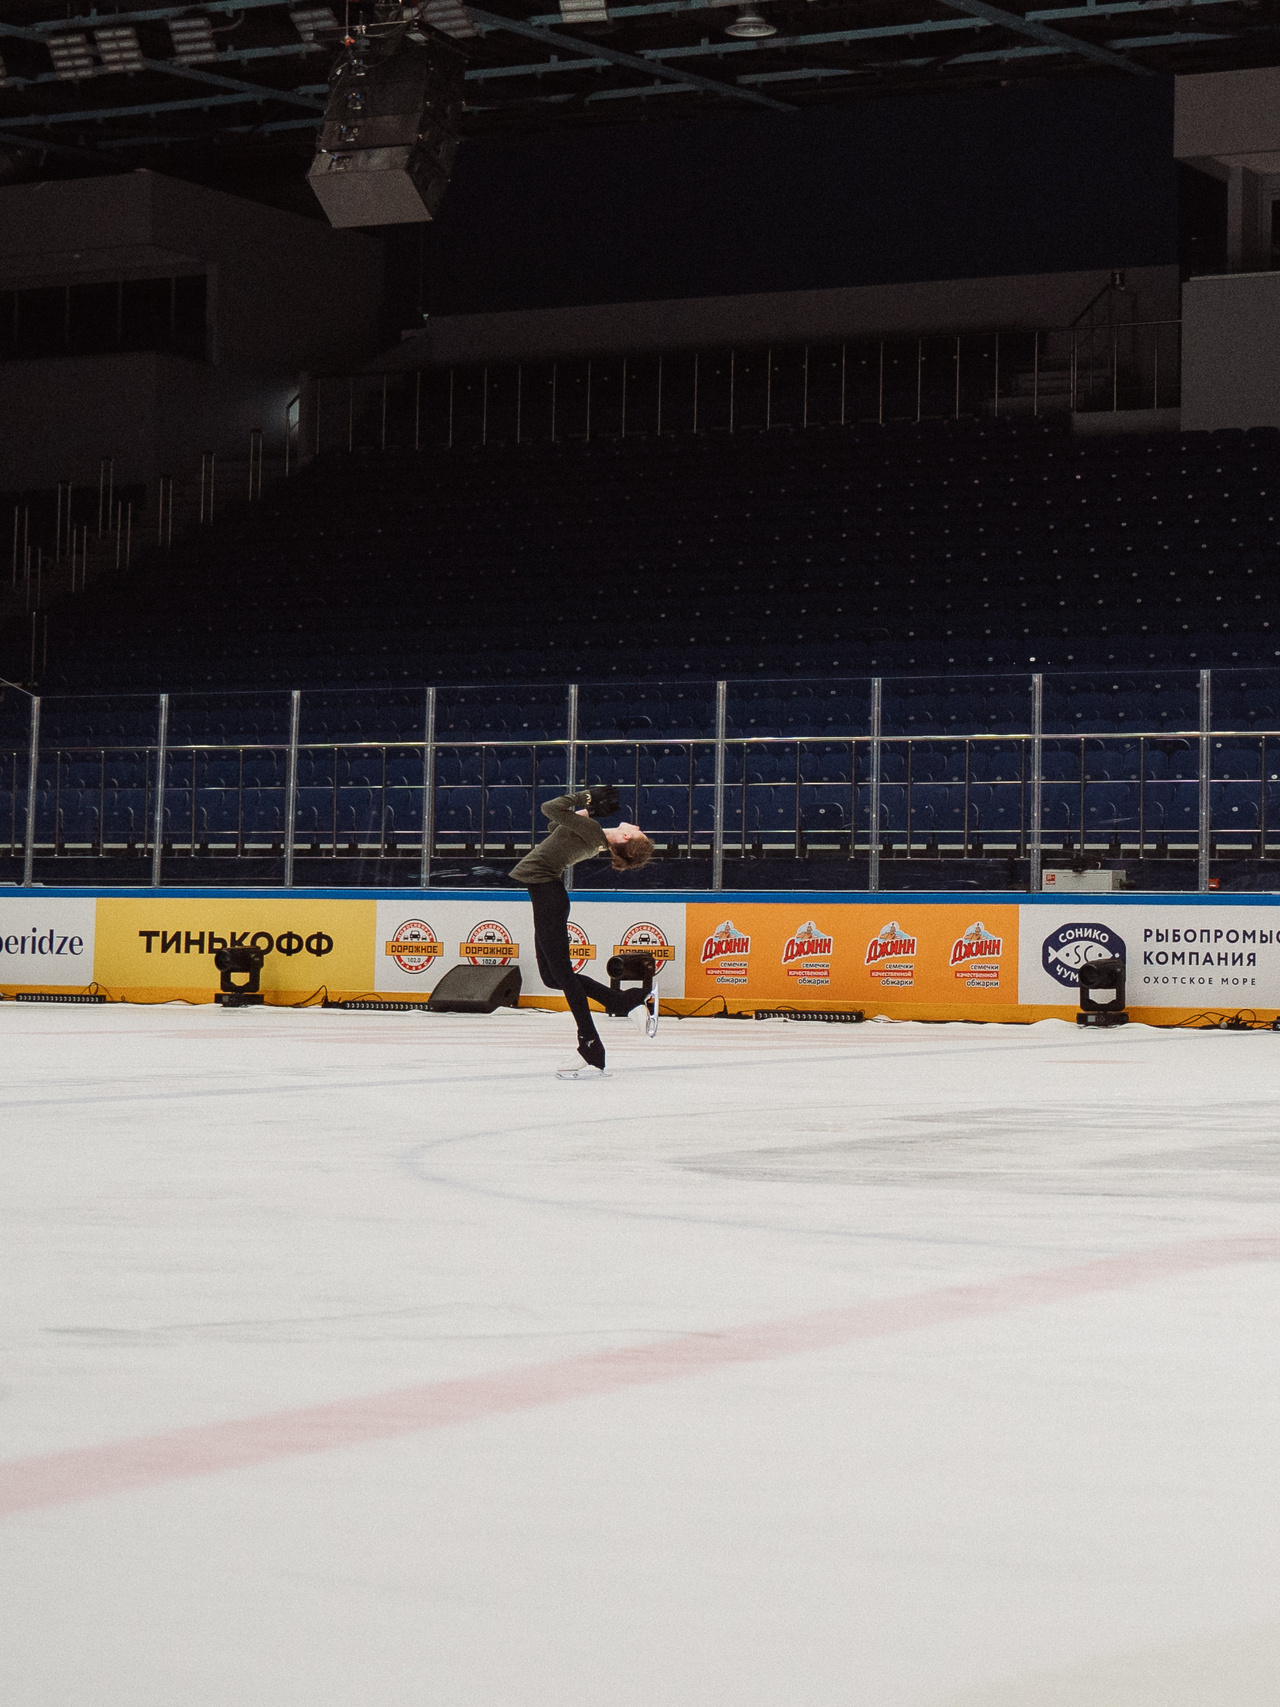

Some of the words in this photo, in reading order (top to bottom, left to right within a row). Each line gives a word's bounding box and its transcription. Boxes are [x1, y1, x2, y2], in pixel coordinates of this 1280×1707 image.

[1058, 927, 1109, 943] СОНИКО
[138, 930, 334, 957] ТИНЬКОФФ
[391, 944, 438, 954] ДОРОЖНОЕ
[465, 946, 514, 955] ДОРОЖНОЕ
[1143, 951, 1256, 967] КОМПАНИЯ
[1056, 964, 1079, 983] ЧУМ
[716, 976, 748, 984] обжарки
[798, 977, 830, 985] обжарки
[881, 978, 913, 986] обжарки
[966, 979, 999, 988] обжарки
[1143, 976, 1213, 985] ОХОТСКОЕ
[1221, 977, 1256, 986] МОРЕ
